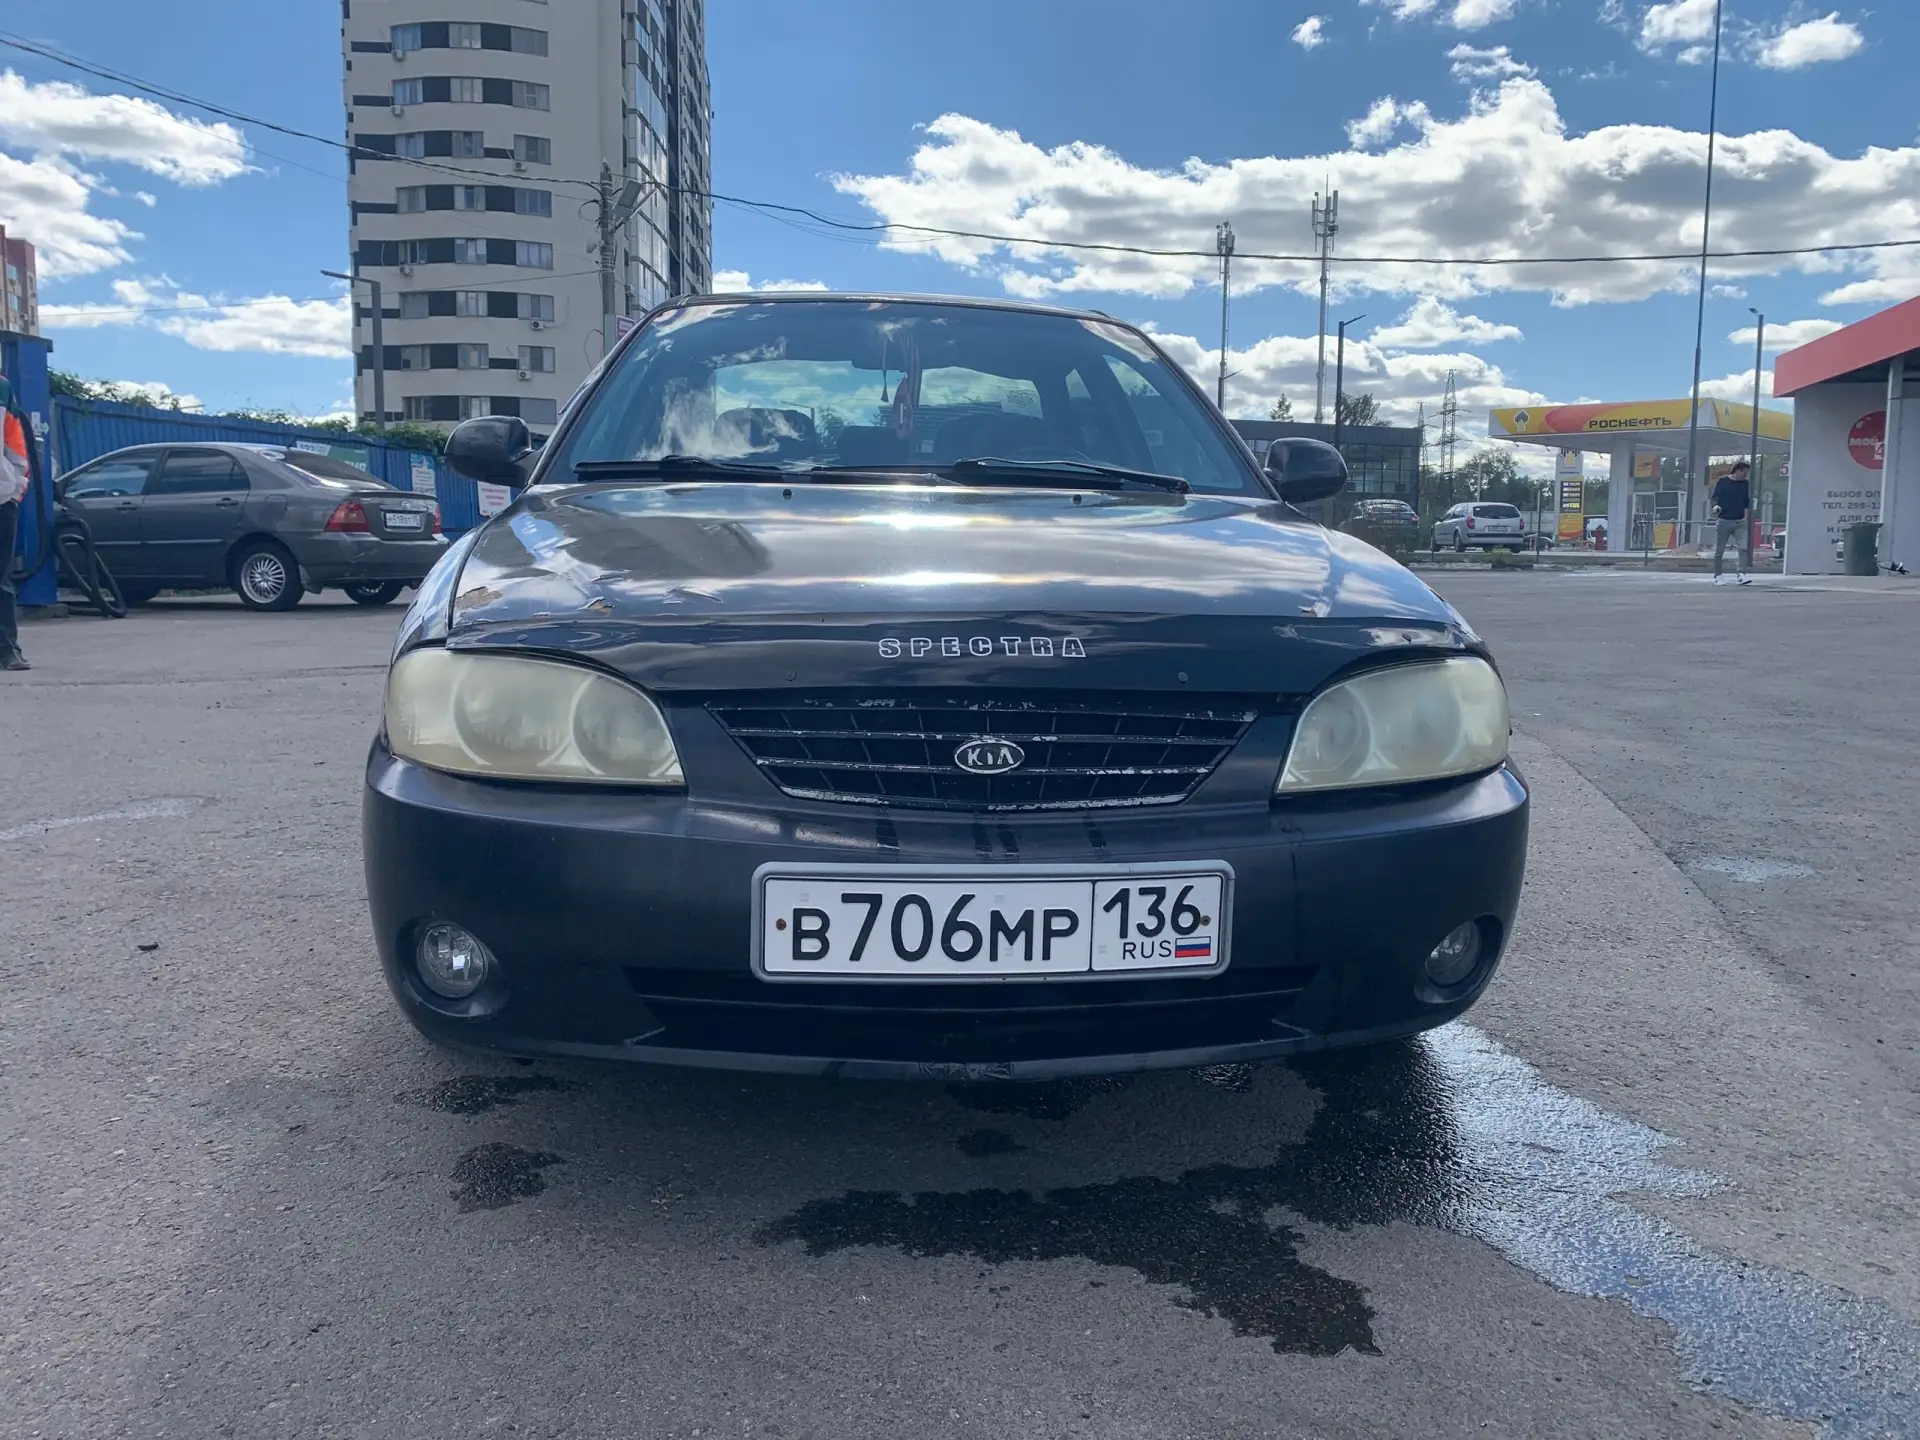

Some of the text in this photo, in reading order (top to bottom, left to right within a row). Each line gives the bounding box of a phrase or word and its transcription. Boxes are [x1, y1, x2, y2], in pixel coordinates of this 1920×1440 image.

[1589, 417, 1672, 429] РОСНЕФТЬ
[1781, 462, 1789, 475] 5
[1827, 490, 1862, 498] ВЫЗОВ
[878, 636, 1087, 659] SPECTRA
[966, 747, 1015, 767] KIA
[792, 884, 1202, 963] В706МР 136
[1122, 941, 1173, 961] RUS
